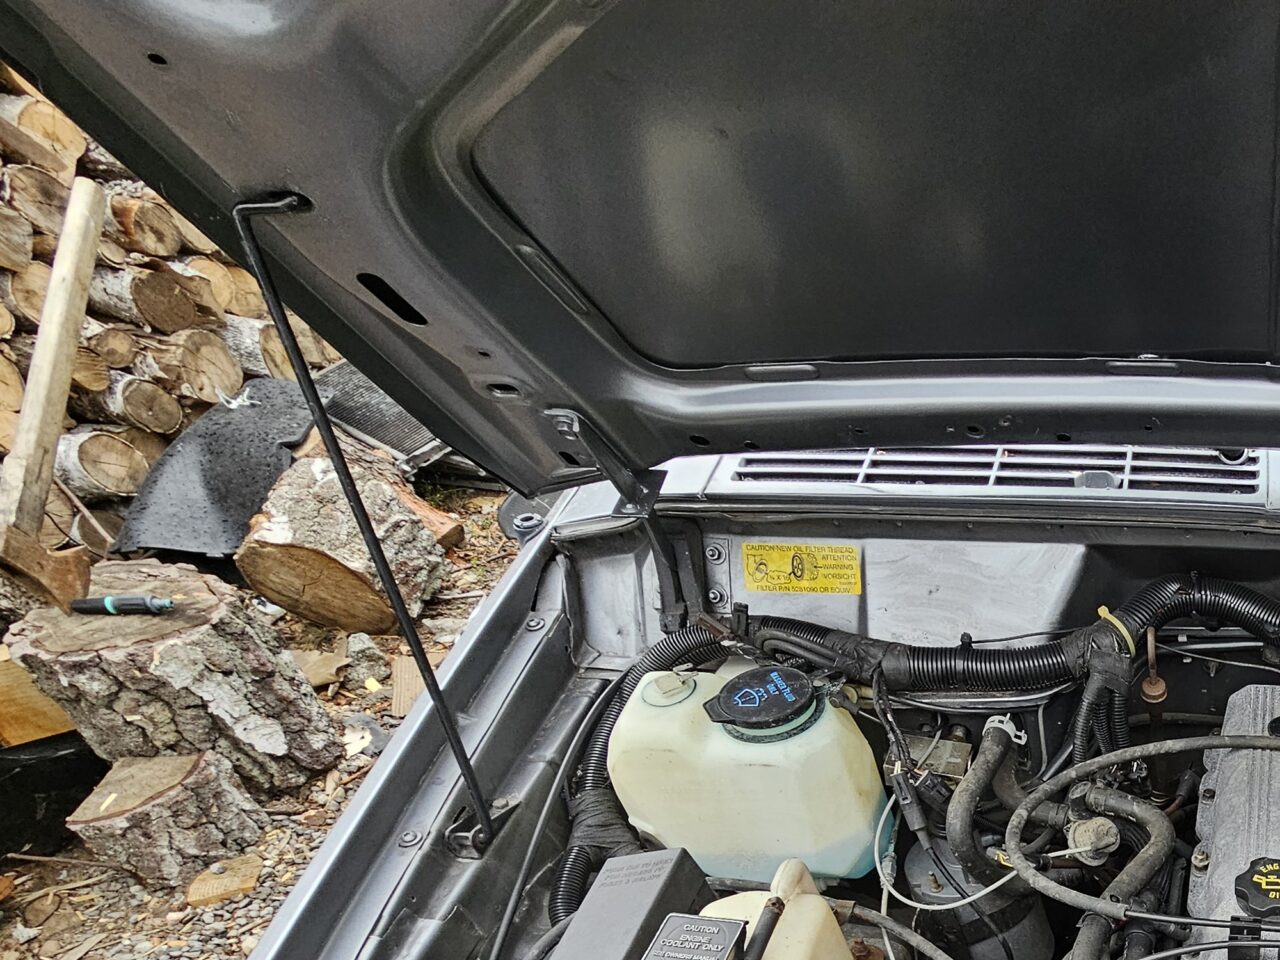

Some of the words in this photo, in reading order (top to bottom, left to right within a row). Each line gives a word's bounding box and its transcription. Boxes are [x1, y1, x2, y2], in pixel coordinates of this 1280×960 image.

[827, 546, 854, 554] THREAD
[684, 924, 720, 934] CAUTION
[680, 934, 712, 944] ENGINE
[660, 938, 702, 950] COOLANT
[702, 943, 725, 952] ONLY
